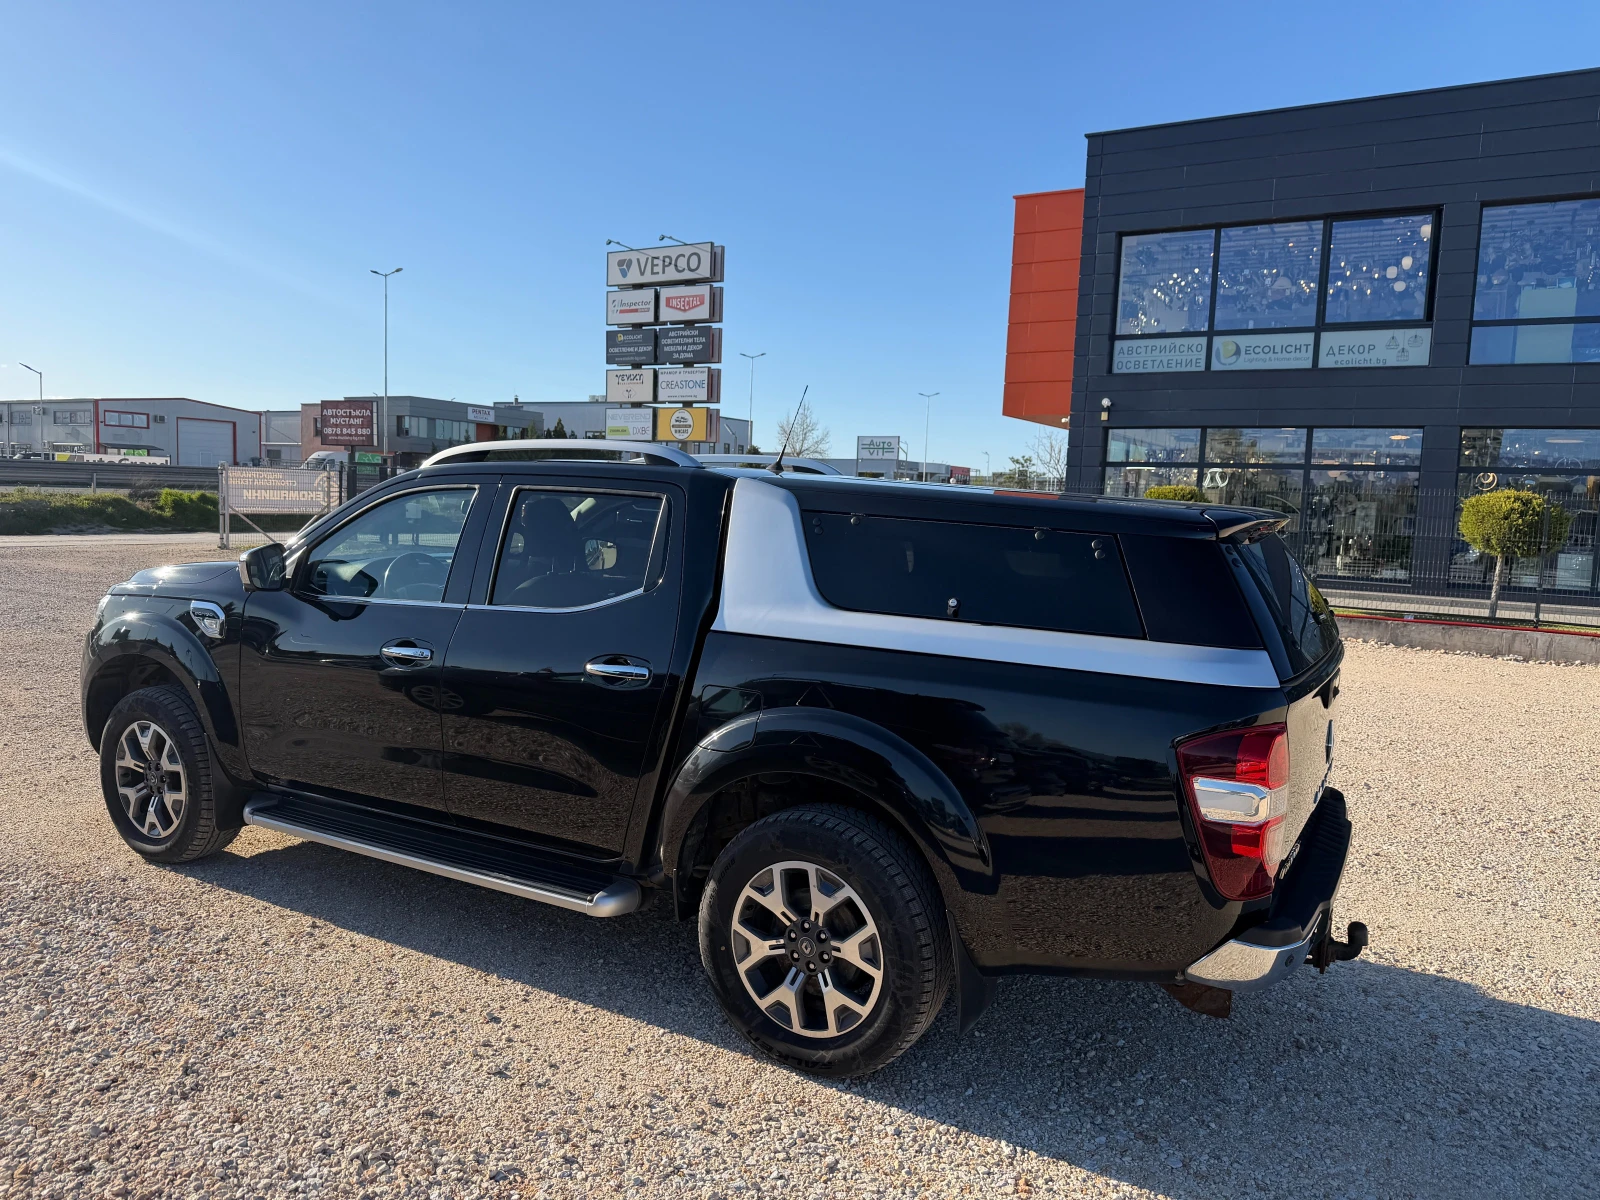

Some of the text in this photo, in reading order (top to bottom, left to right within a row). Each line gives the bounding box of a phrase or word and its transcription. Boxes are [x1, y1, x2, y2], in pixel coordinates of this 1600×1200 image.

[636, 252, 701, 276] VEPCO
[669, 297, 701, 309] INSECTAL
[1117, 342, 1203, 356] АВСТРИЙСКО
[1245, 344, 1312, 355] ECOLICHT
[1326, 344, 1376, 357] ДЕКОР
[1116, 357, 1202, 370] ОСВЕТЛЕНИЕ
[1334, 357, 1387, 365] ecolicht.bg
[660, 379, 706, 390] CREASTONE
[330, 417, 364, 425] МУСТАНГ
